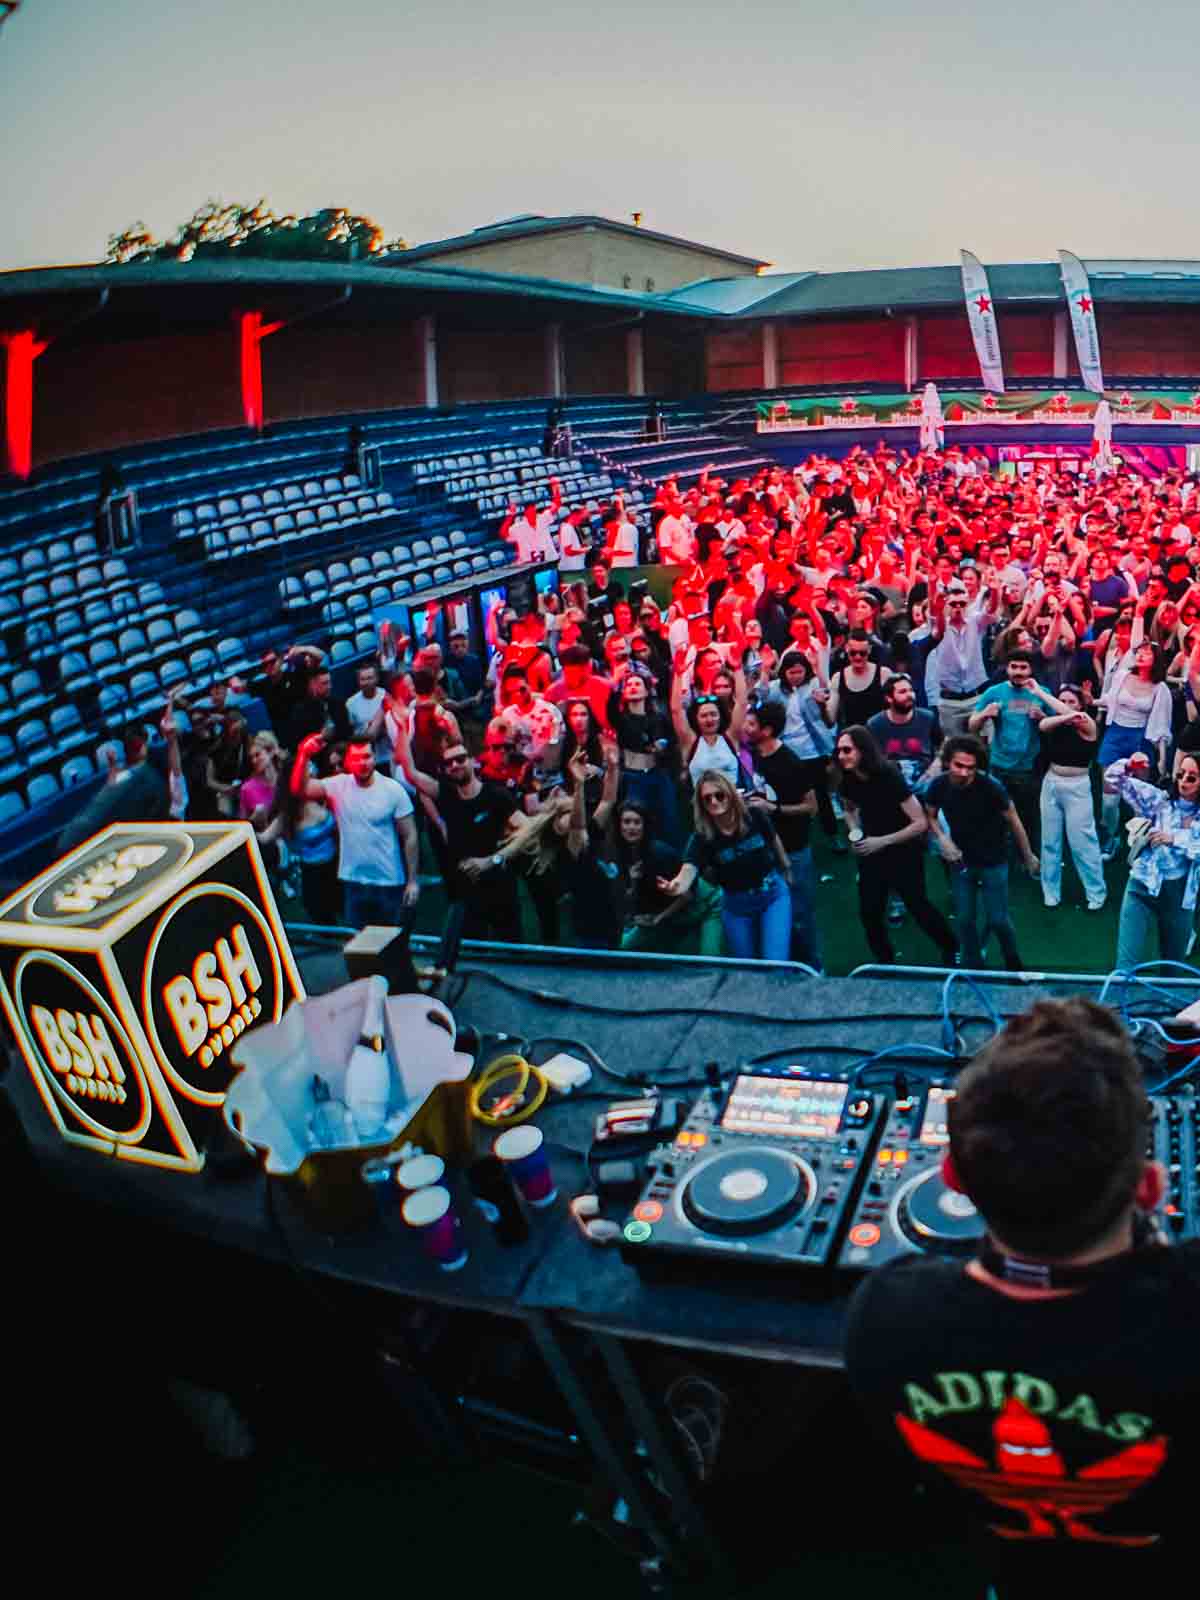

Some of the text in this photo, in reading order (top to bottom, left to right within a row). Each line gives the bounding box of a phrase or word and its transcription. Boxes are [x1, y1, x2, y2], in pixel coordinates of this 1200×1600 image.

[162, 922, 262, 1057] BSH
[30, 1004, 127, 1083] BSH
[903, 1370, 1153, 1441] ADIDAS
